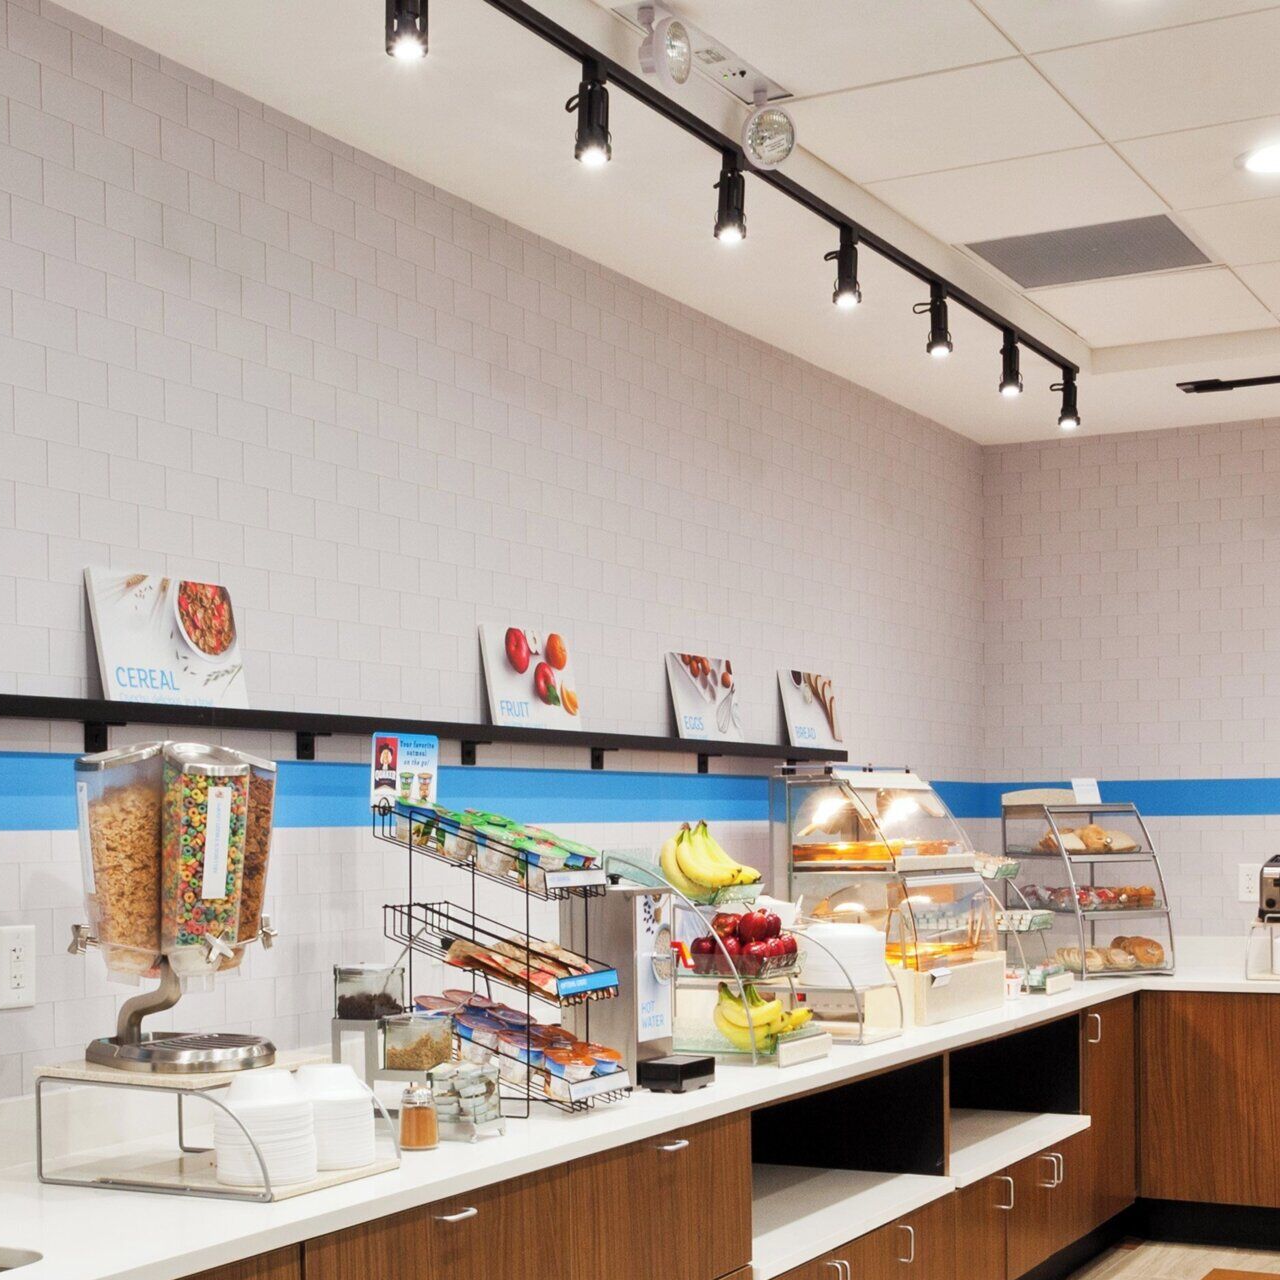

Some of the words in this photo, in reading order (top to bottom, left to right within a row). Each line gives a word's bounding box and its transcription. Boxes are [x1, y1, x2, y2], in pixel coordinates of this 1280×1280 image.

[115, 666, 180, 691] CEREAL
[500, 700, 529, 718] FRUIT
[683, 715, 705, 731] EGGS
[794, 725, 817, 740] BREAD
[640, 1000, 656, 1014] HOT
[641, 1014, 666, 1029] WATER
